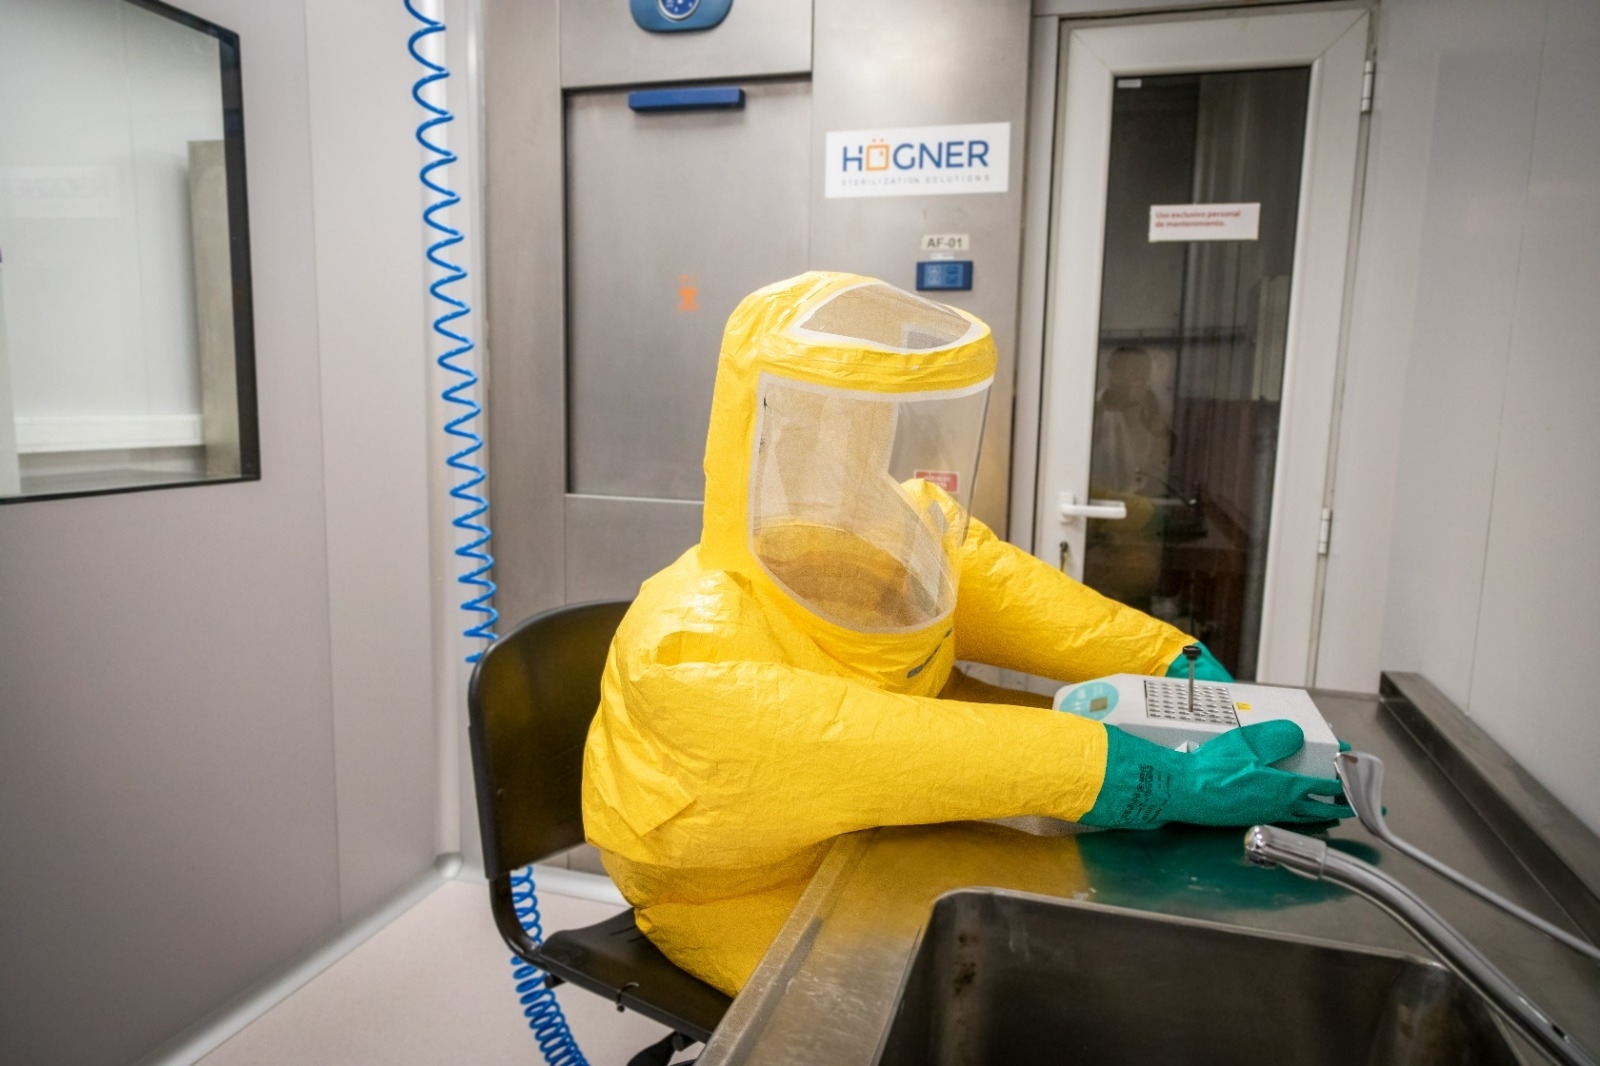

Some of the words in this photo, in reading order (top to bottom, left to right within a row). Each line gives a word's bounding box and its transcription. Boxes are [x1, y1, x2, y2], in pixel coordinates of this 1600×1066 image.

[841, 177, 920, 186] STERILIZATION
[925, 174, 990, 184] SOLUTIONS
[1207, 210, 1241, 219] personal
[927, 237, 962, 249] AF-01
